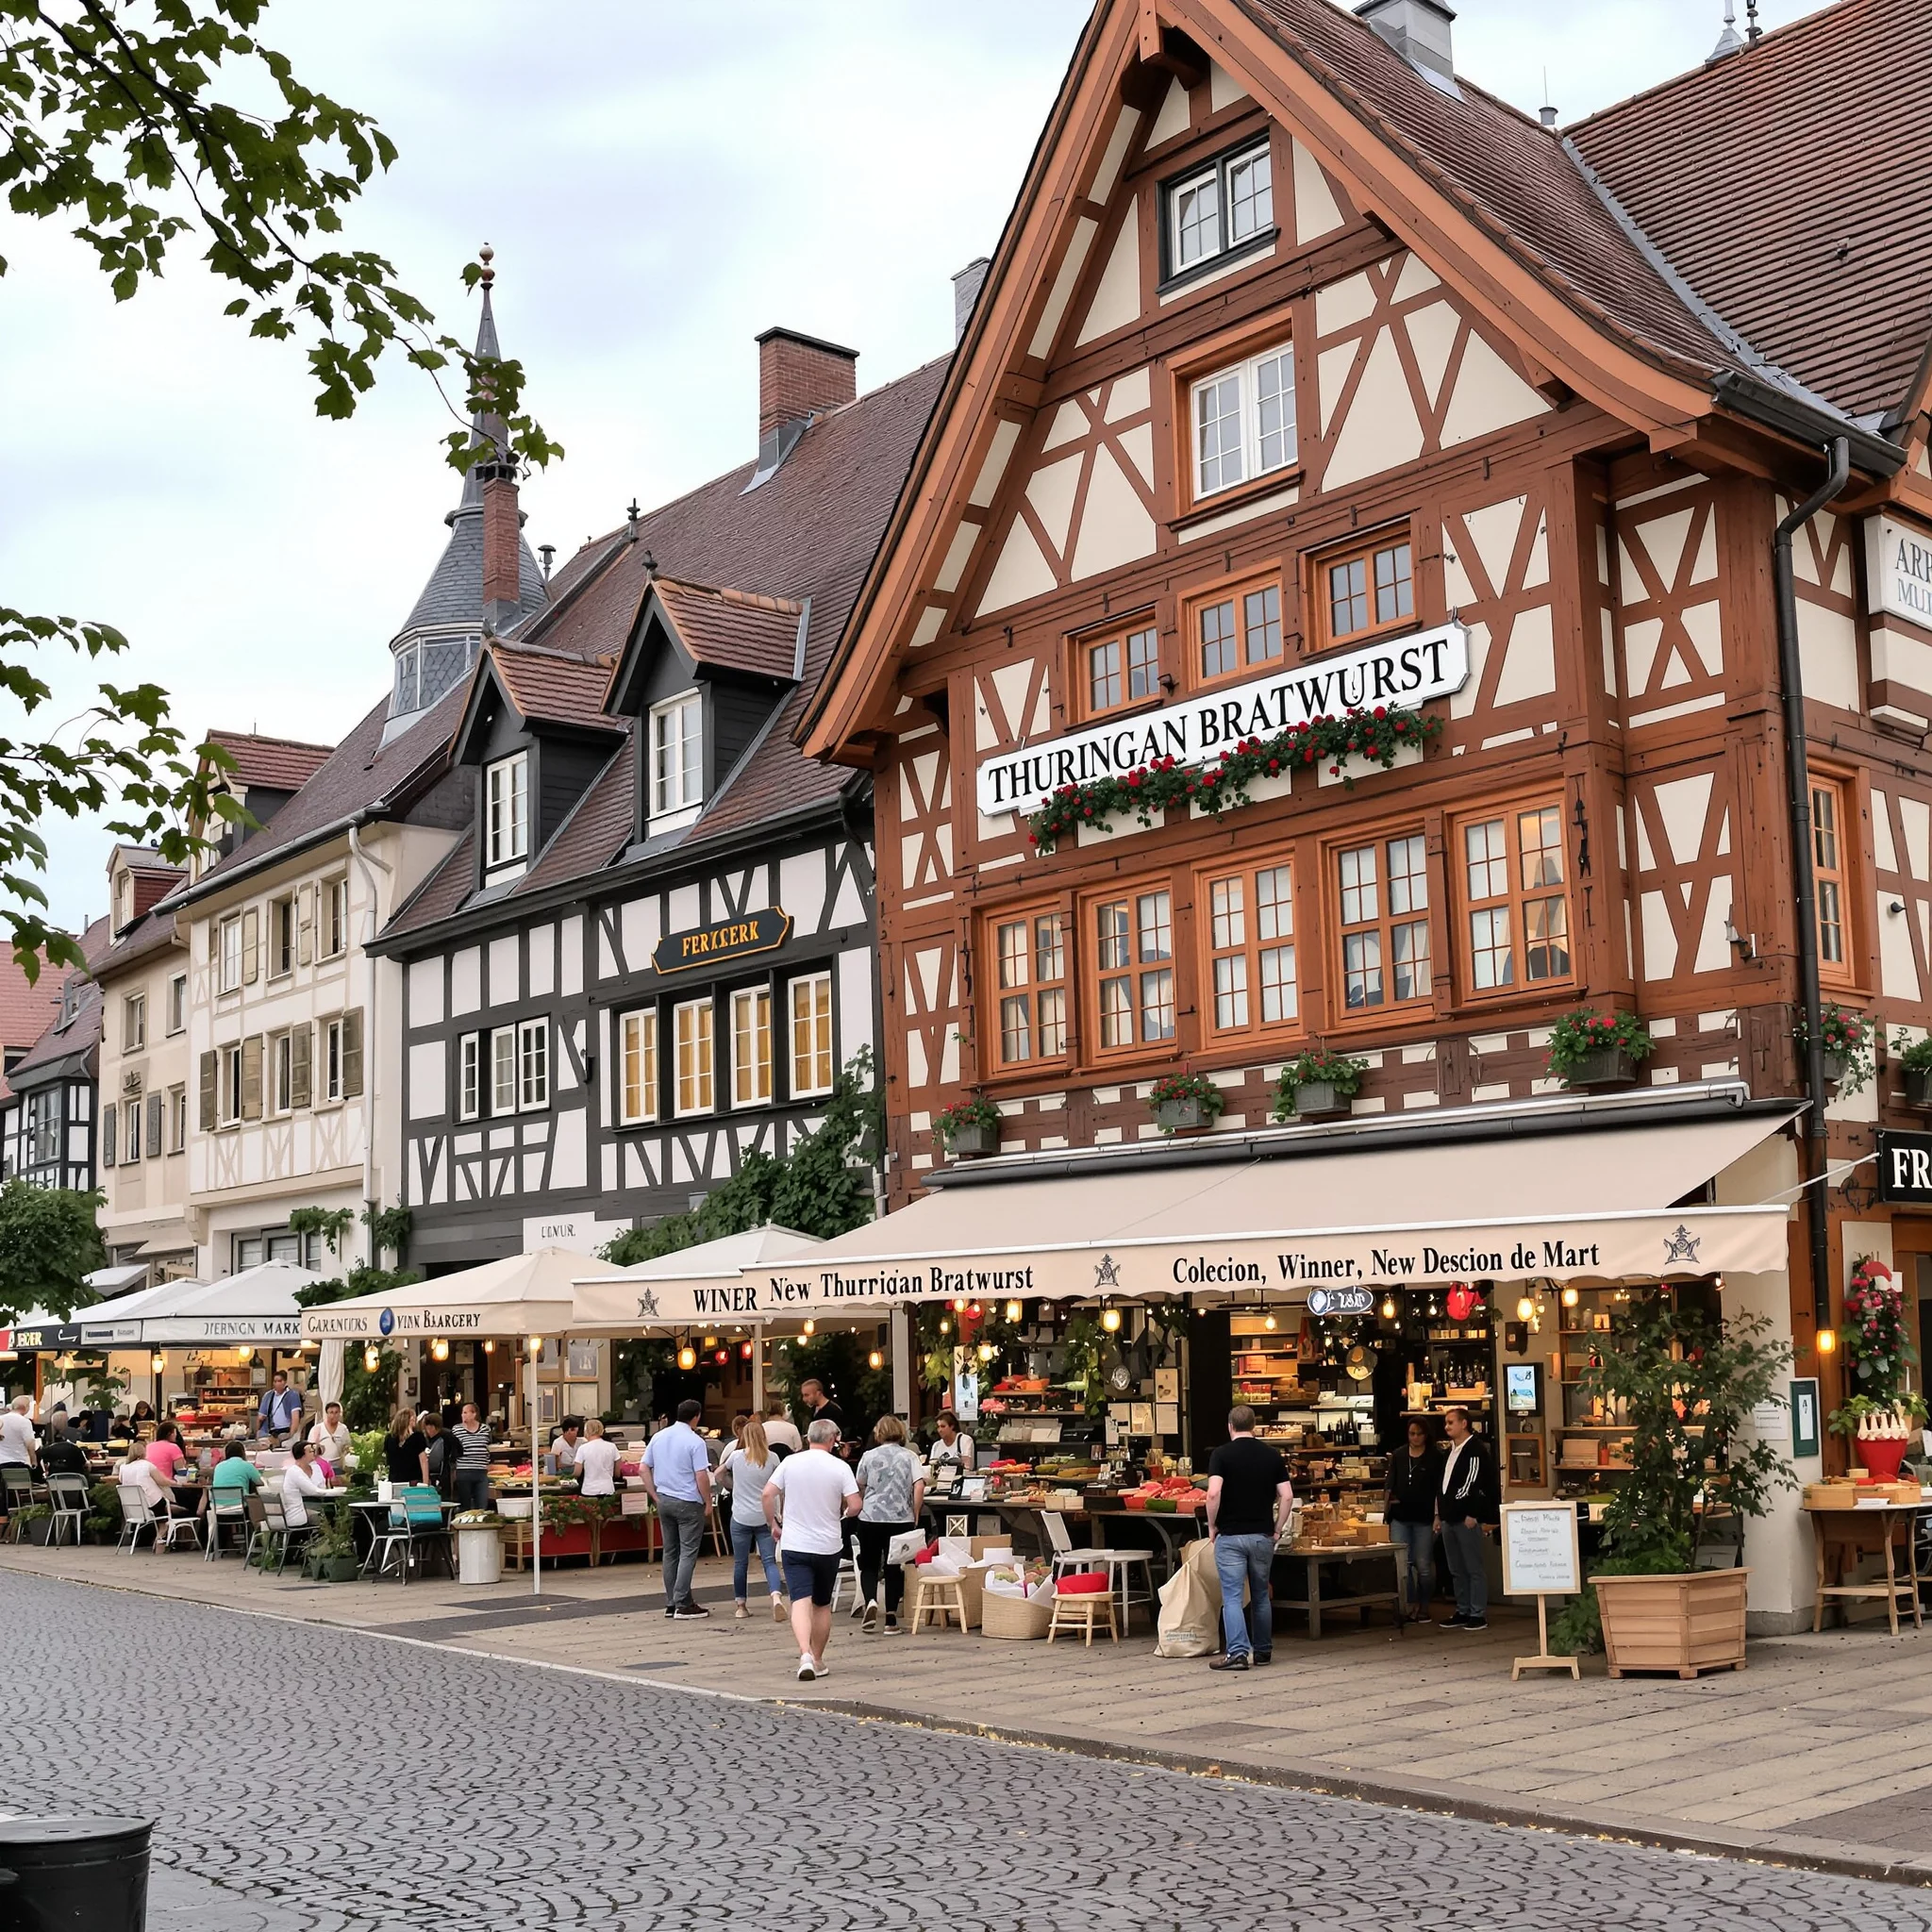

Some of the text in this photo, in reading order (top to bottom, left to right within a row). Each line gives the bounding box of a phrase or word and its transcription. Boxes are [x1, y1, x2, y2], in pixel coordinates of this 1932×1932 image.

[989, 639, 1448, 804] THURINGAN BRATWURST
[1173, 1240, 1601, 1285] Colecion, Winner, New Descion de Mart
[693, 1287, 758, 1312] WINER
[770, 1276, 812, 1302] New
[929, 1265, 1034, 1292] Bratwurst
